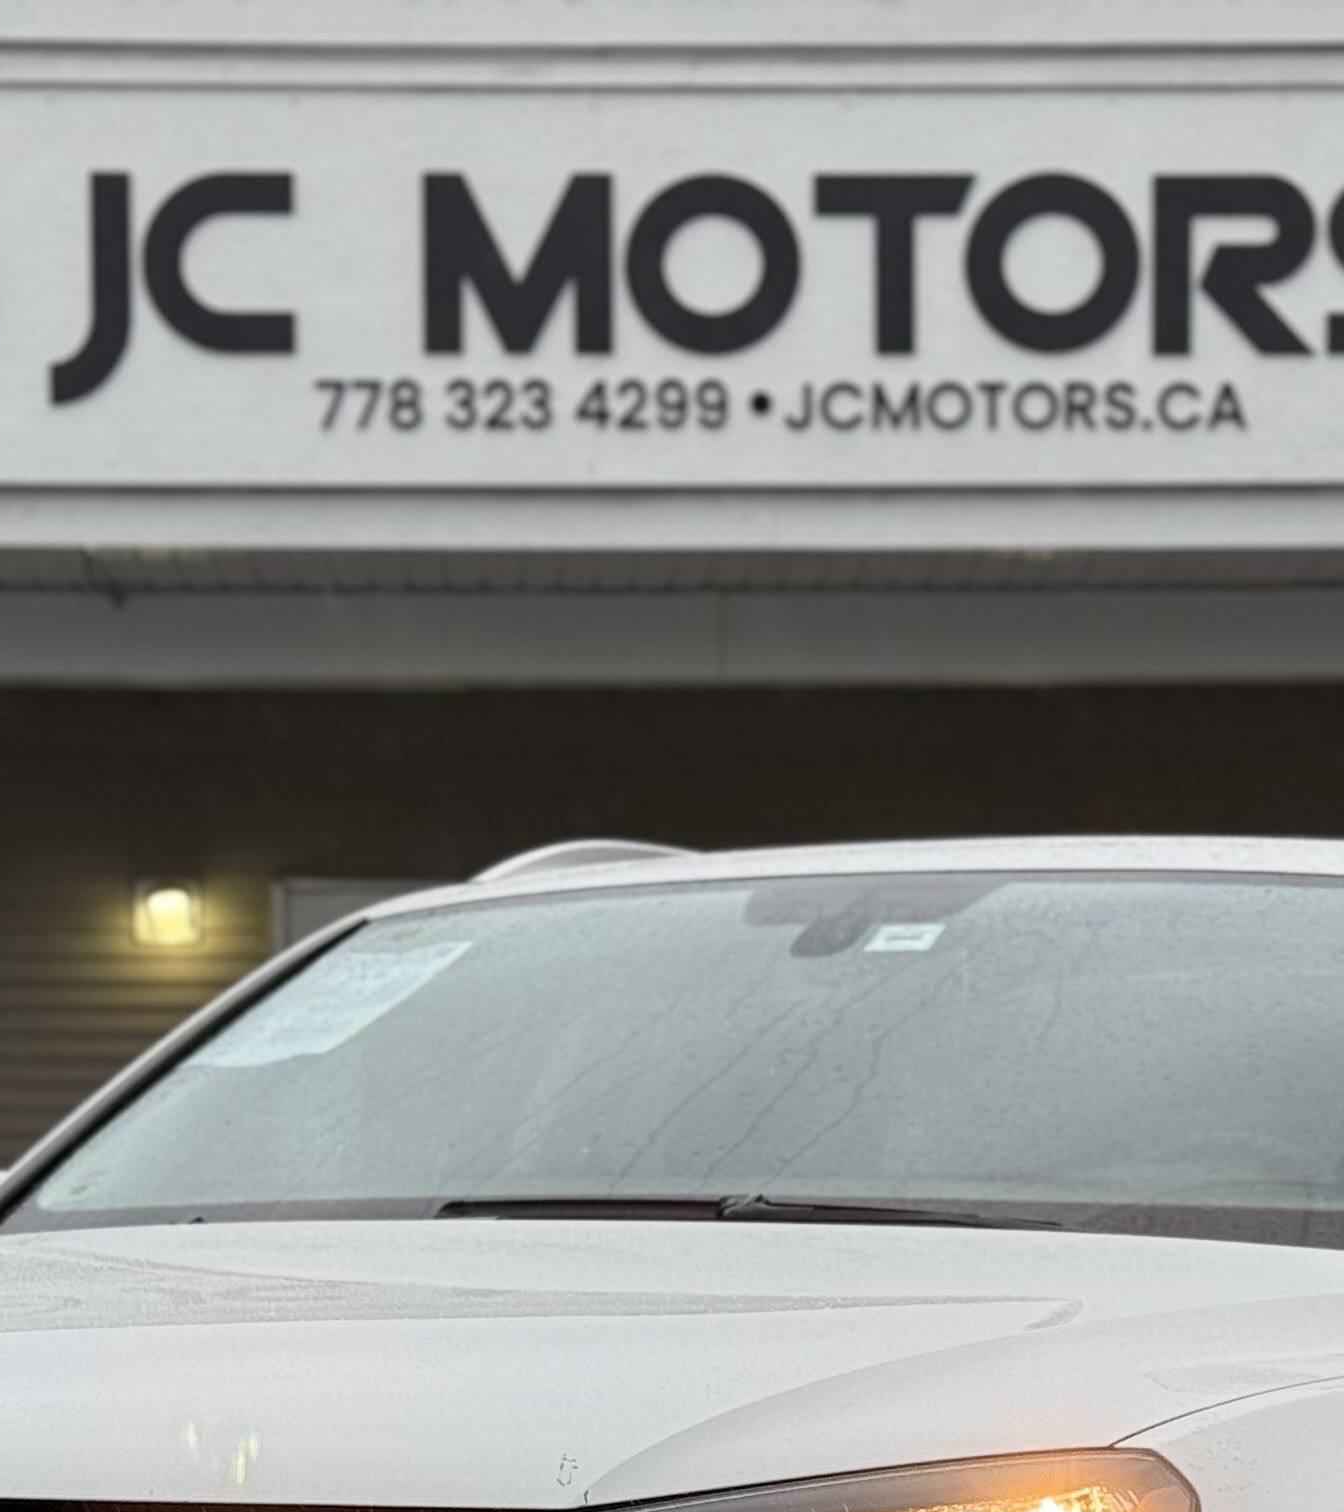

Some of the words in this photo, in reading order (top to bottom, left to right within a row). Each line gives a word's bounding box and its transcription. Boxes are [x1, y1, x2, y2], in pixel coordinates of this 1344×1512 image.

[49, 171, 295, 405] JC
[313, 378, 424, 432] 778
[444, 378, 553, 432] 323
[573, 378, 731, 432] 4299
[784, 381, 1249, 432] JCMOTORS.CA
